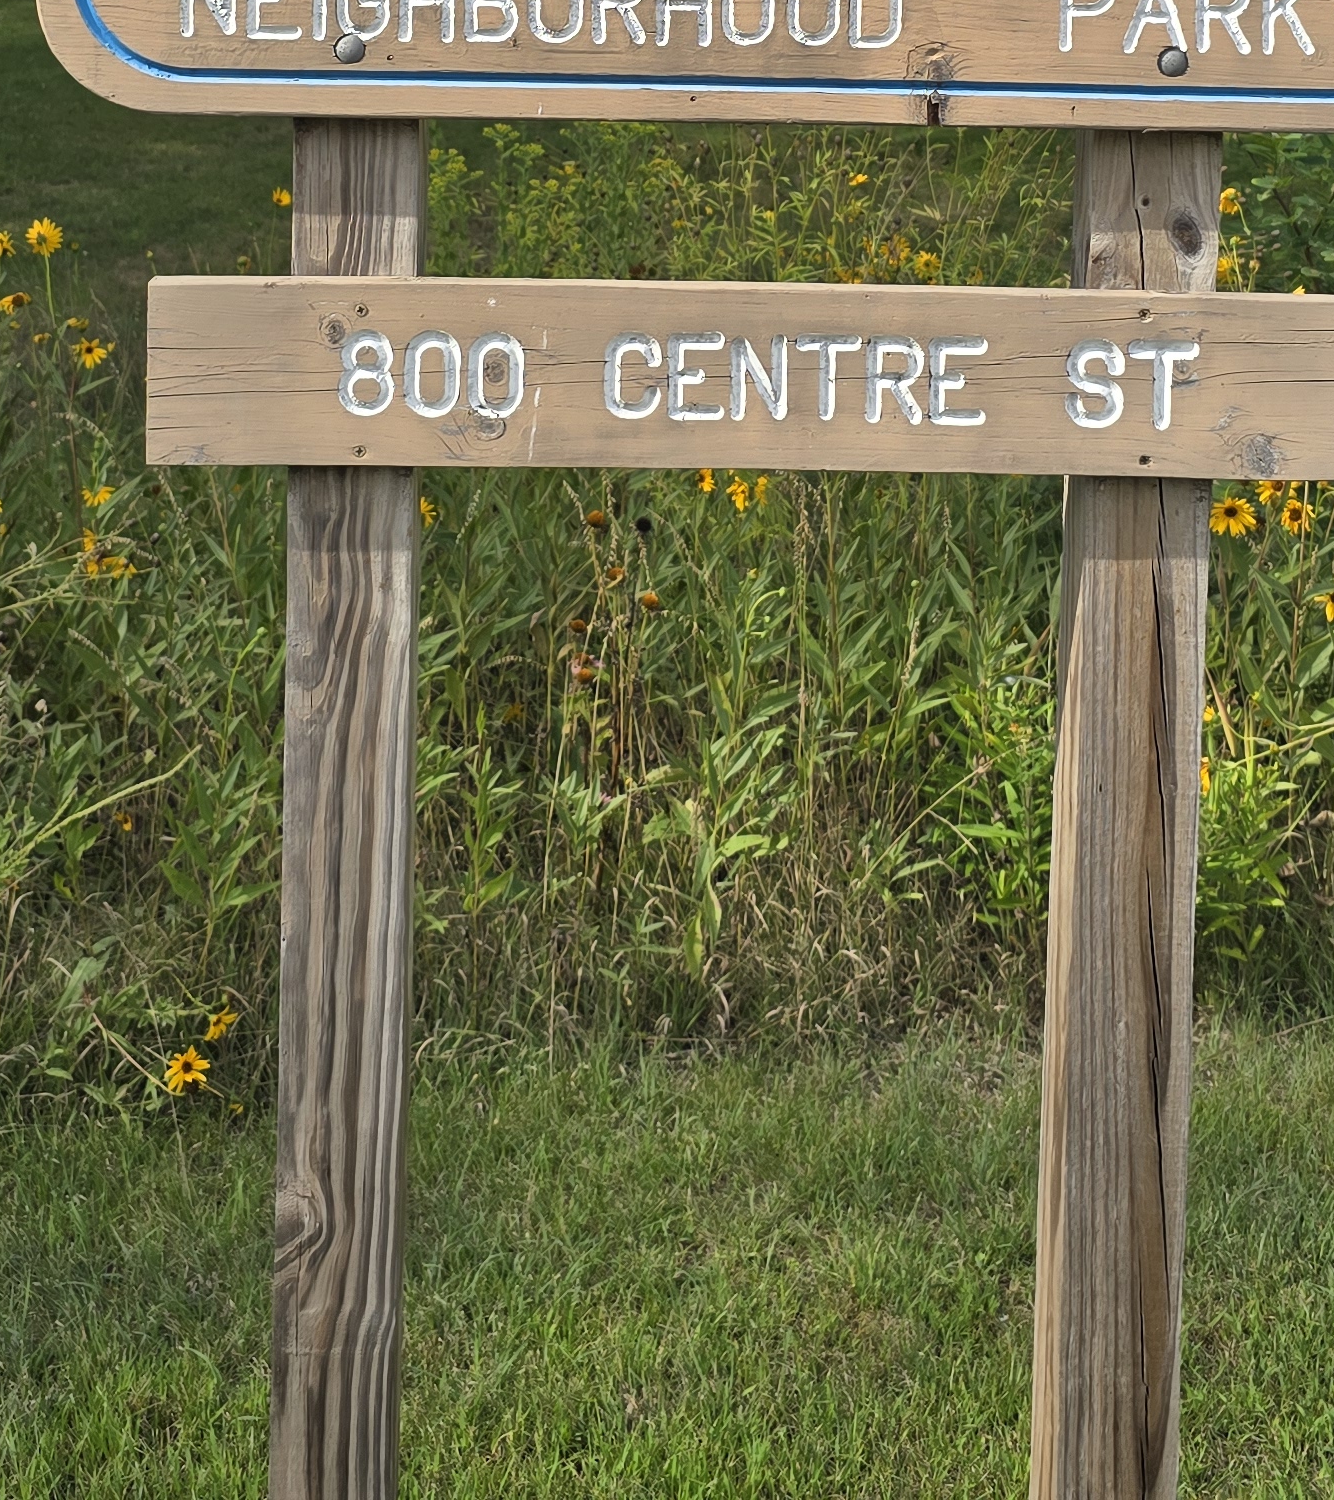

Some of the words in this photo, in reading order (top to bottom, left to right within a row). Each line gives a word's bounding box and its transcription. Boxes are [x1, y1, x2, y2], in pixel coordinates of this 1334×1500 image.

[337, 328, 526, 420] 800
[602, 330, 990, 427] CENTRE
[1064, 337, 1201, 432] ST
